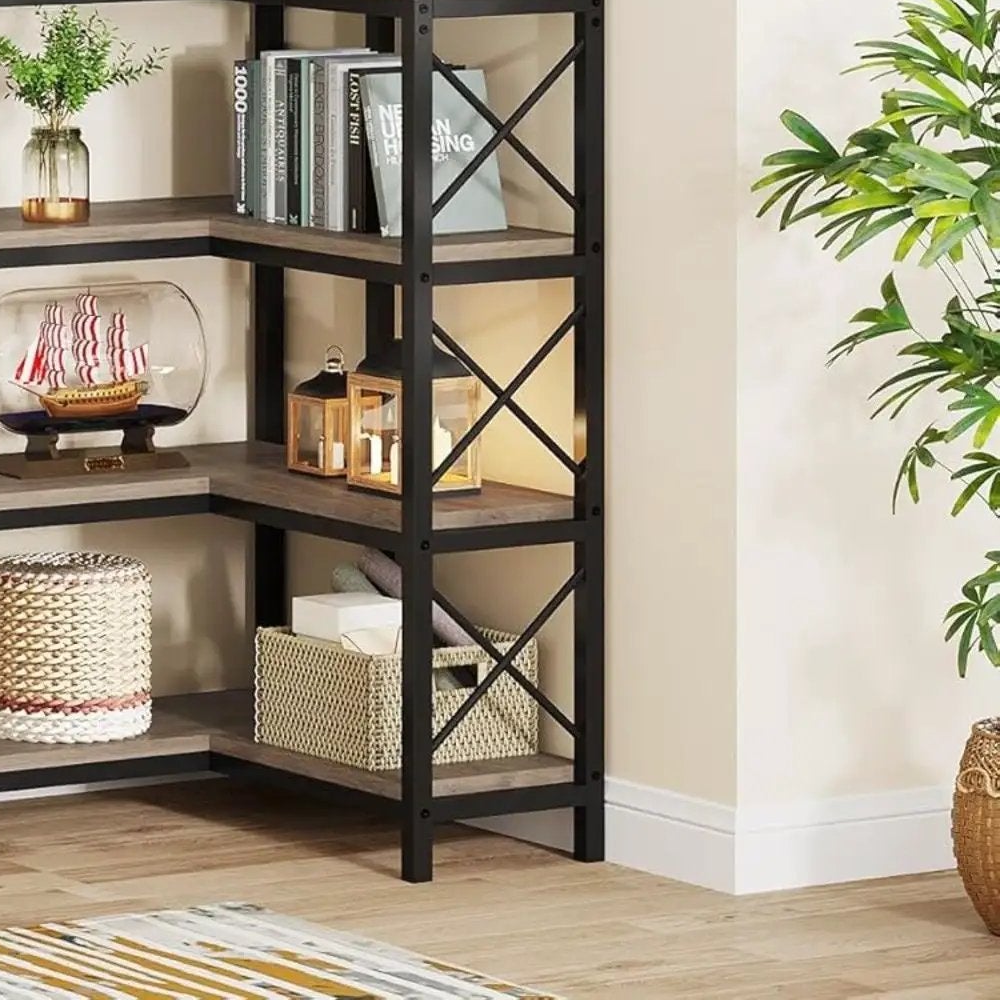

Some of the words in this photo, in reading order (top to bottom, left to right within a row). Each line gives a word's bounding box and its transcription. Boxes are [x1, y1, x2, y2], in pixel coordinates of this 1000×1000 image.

[234, 65, 248, 113] 1000
[349, 72, 360, 110] LOST
[349, 112, 360, 145] FISH
[378, 103, 402, 119] NE
